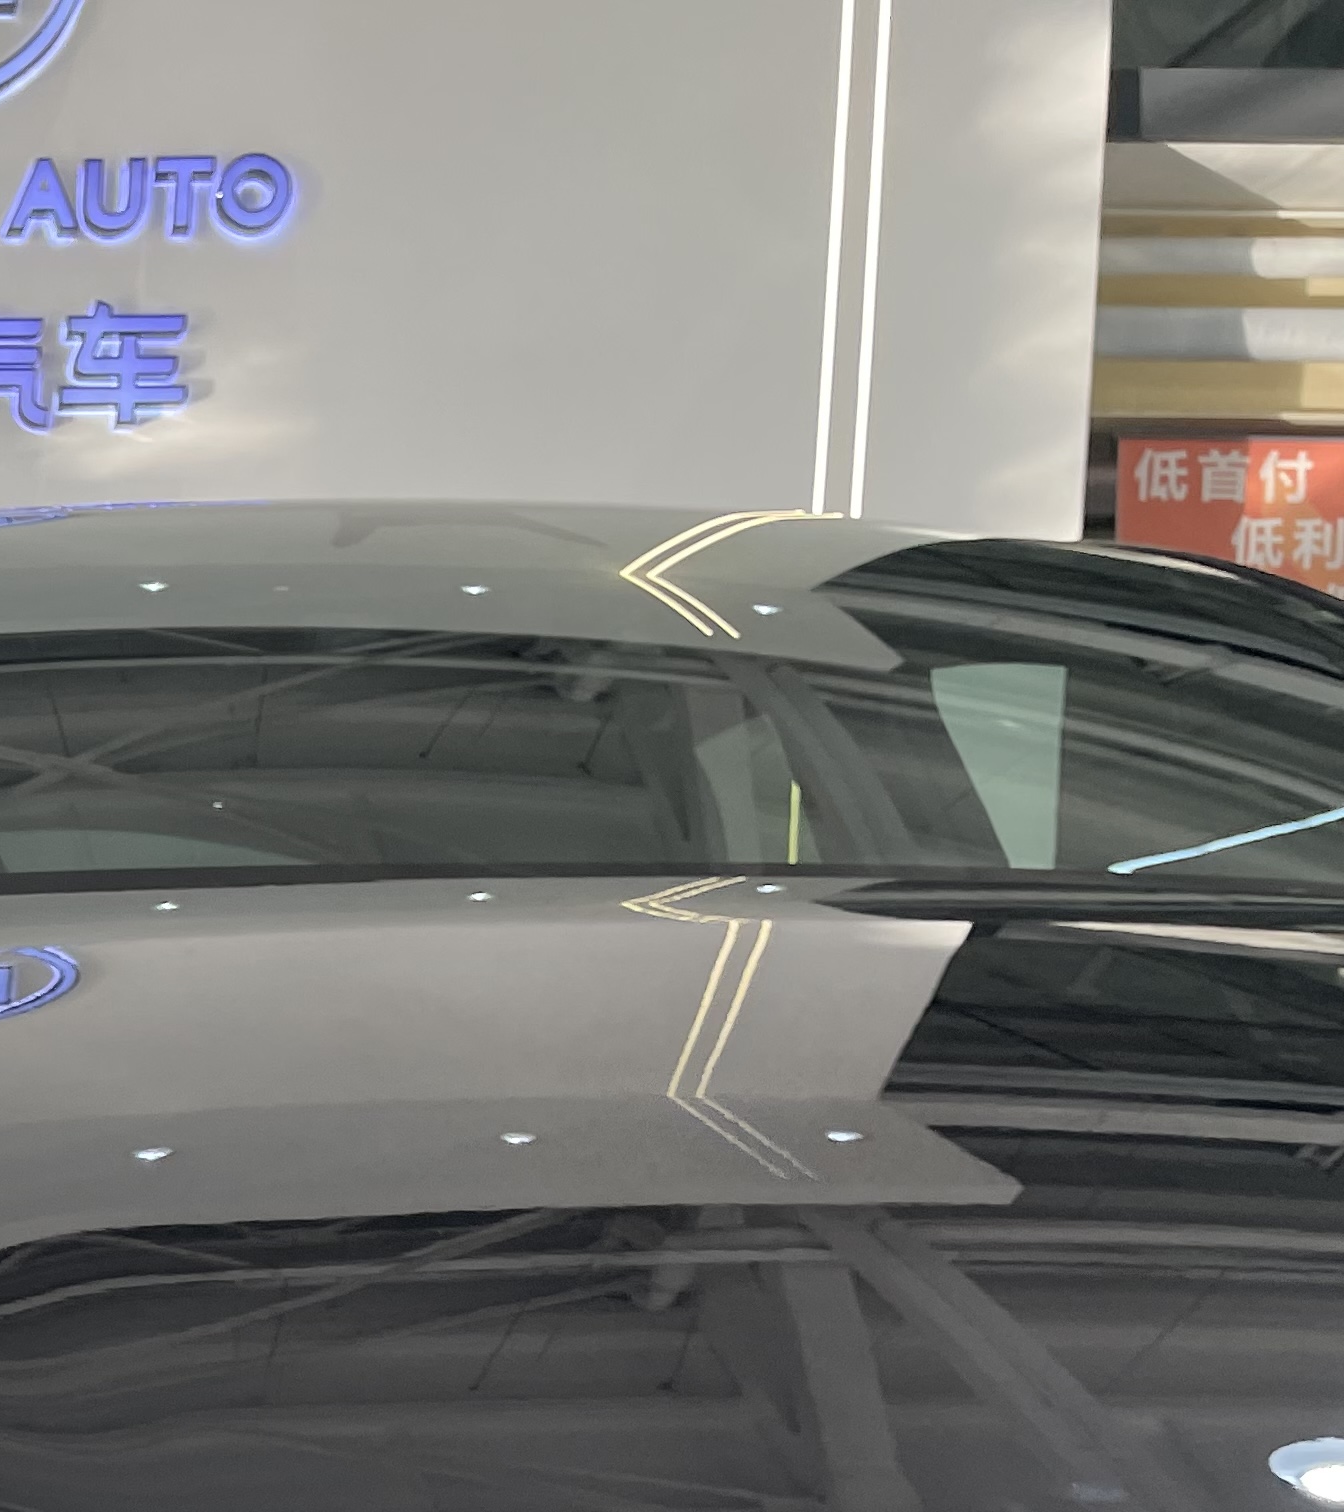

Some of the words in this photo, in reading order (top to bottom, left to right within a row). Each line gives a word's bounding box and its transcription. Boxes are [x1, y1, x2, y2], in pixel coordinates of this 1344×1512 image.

[1, 153, 295, 241] AUTO
[1134, 447, 1315, 504] 低首付
